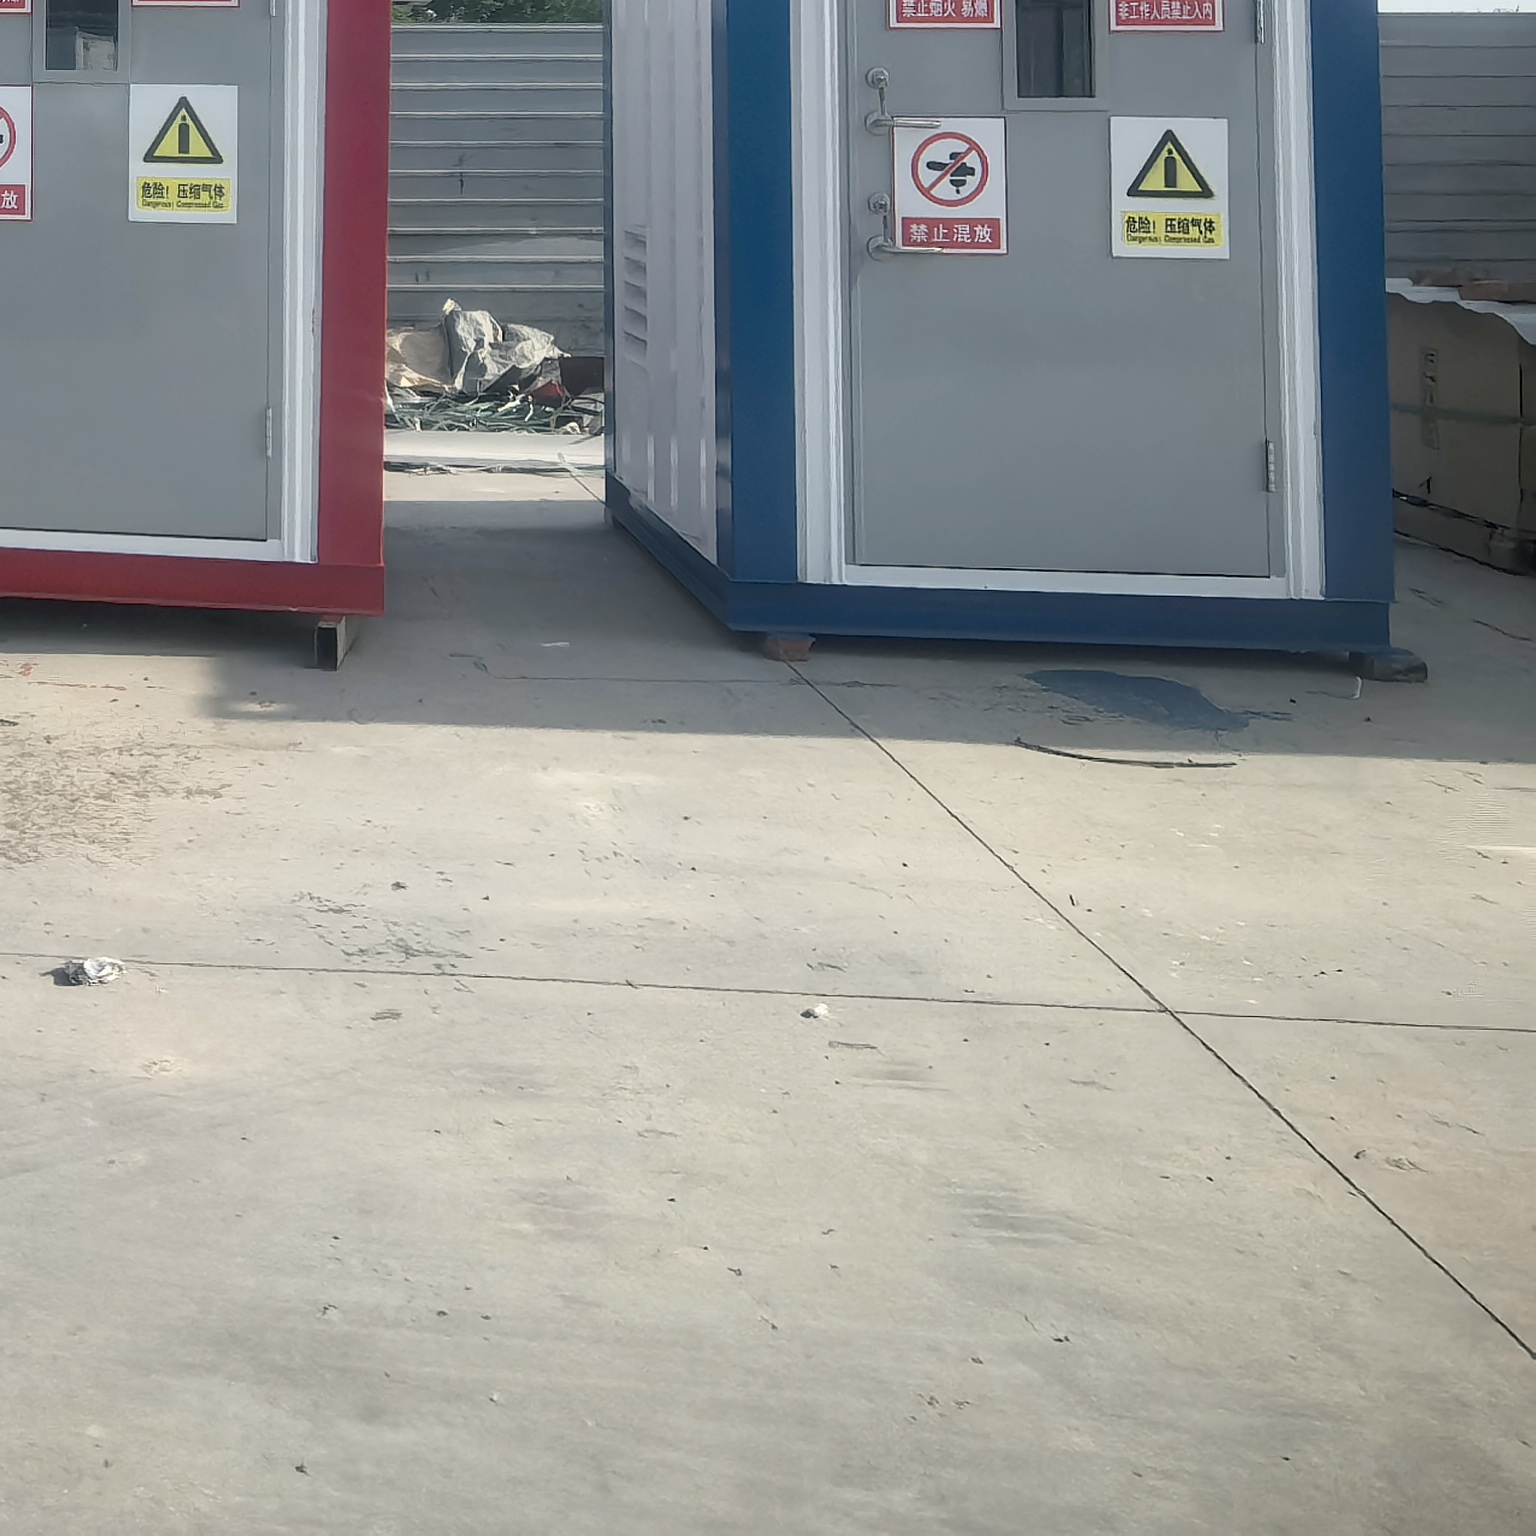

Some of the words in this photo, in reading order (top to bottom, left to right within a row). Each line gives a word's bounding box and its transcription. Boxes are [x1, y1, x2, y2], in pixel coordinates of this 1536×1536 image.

[1118, 0, 1213, 20] 非工作人员禁止入内
[910, 223, 993, 243] 禁止混放
